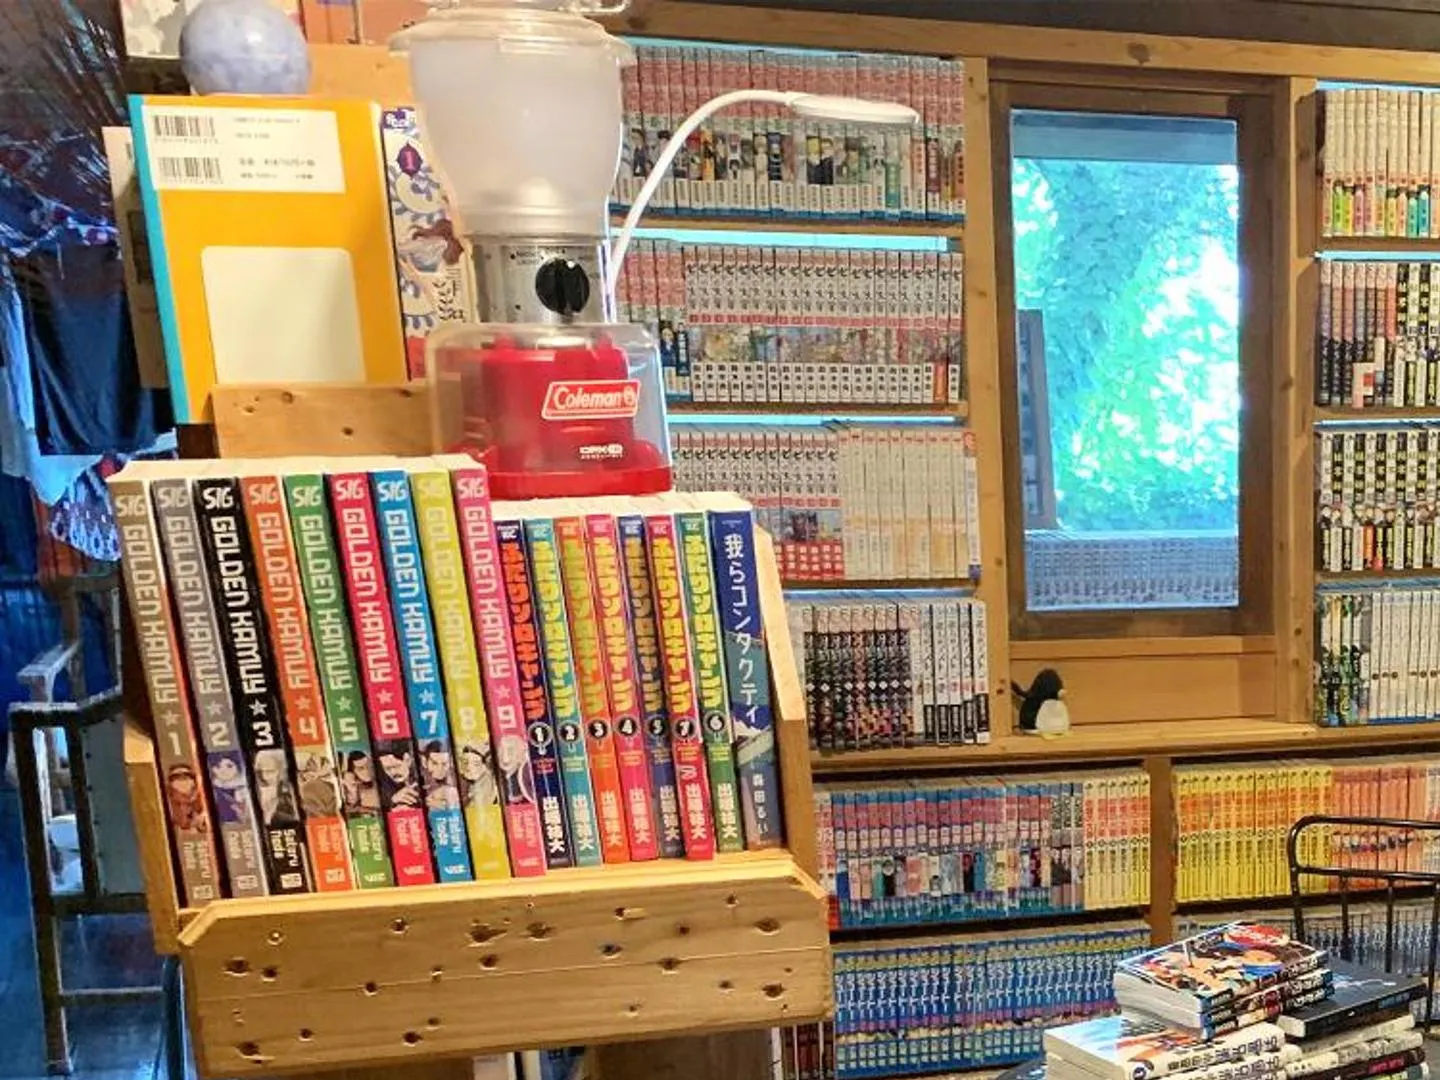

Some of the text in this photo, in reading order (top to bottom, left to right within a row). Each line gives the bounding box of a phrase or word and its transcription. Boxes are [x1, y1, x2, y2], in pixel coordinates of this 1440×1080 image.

[554, 386, 624, 409] Coleman
[379, 711, 399, 733] 6
[420, 711, 438, 734] 7
[459, 708, 477, 730] 8
[498, 704, 517, 728] 9
[621, 719, 633, 734] 4
[709, 715, 722, 731] 6
[208, 723, 230, 746] 2
[254, 722, 273, 746] 3
[299, 719, 317, 740] 4
[340, 718, 358, 742] 5
[534, 726, 545, 743] 1
[564, 724, 575, 741] 2
[595, 721, 606, 736] 3
[679, 721, 690, 737] 7
[168, 733, 181, 755] 1
[270, 831, 284, 859] Noda
[283, 829, 299, 867] Satoru
